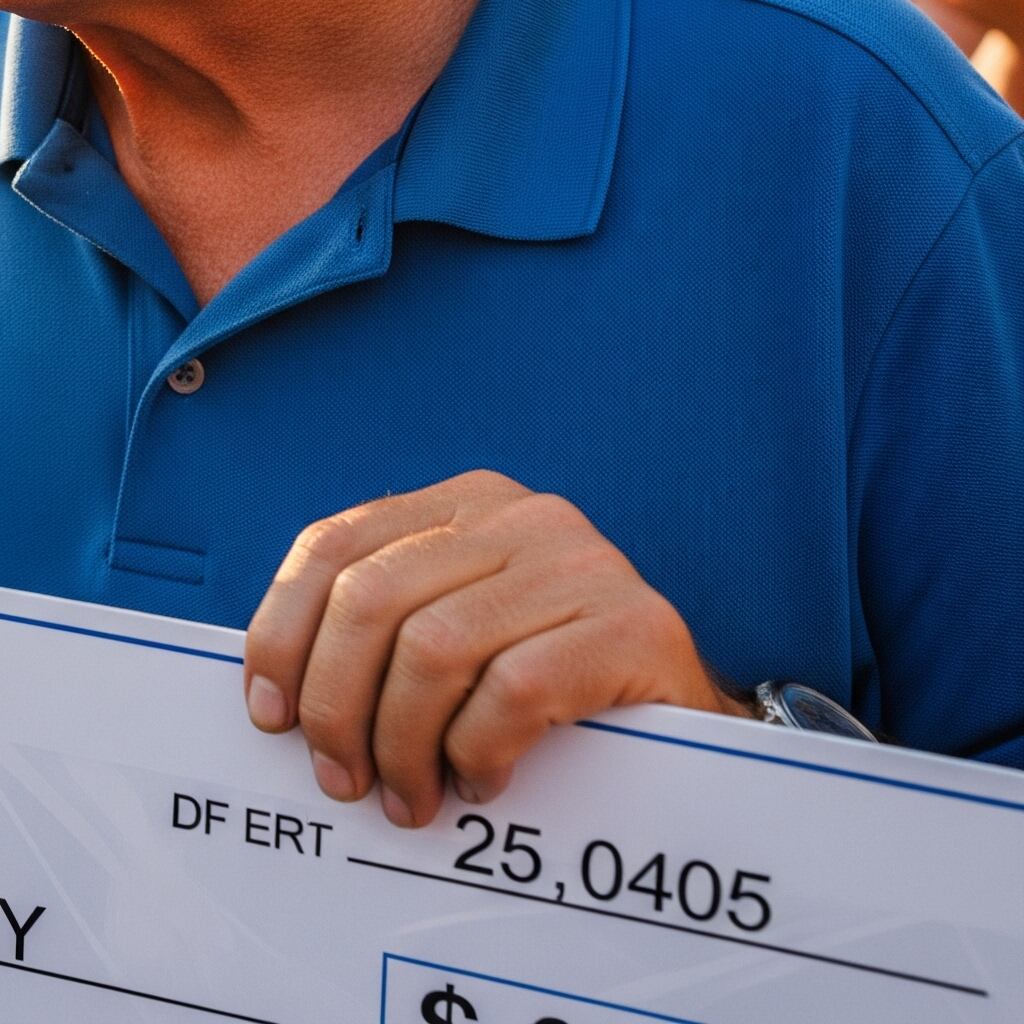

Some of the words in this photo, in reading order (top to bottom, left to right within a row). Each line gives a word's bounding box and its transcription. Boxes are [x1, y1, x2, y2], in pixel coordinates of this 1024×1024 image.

[172, 792, 229, 835] DF
[245, 807, 334, 858] ERT
[453, 812, 772, 933] 25,0405
